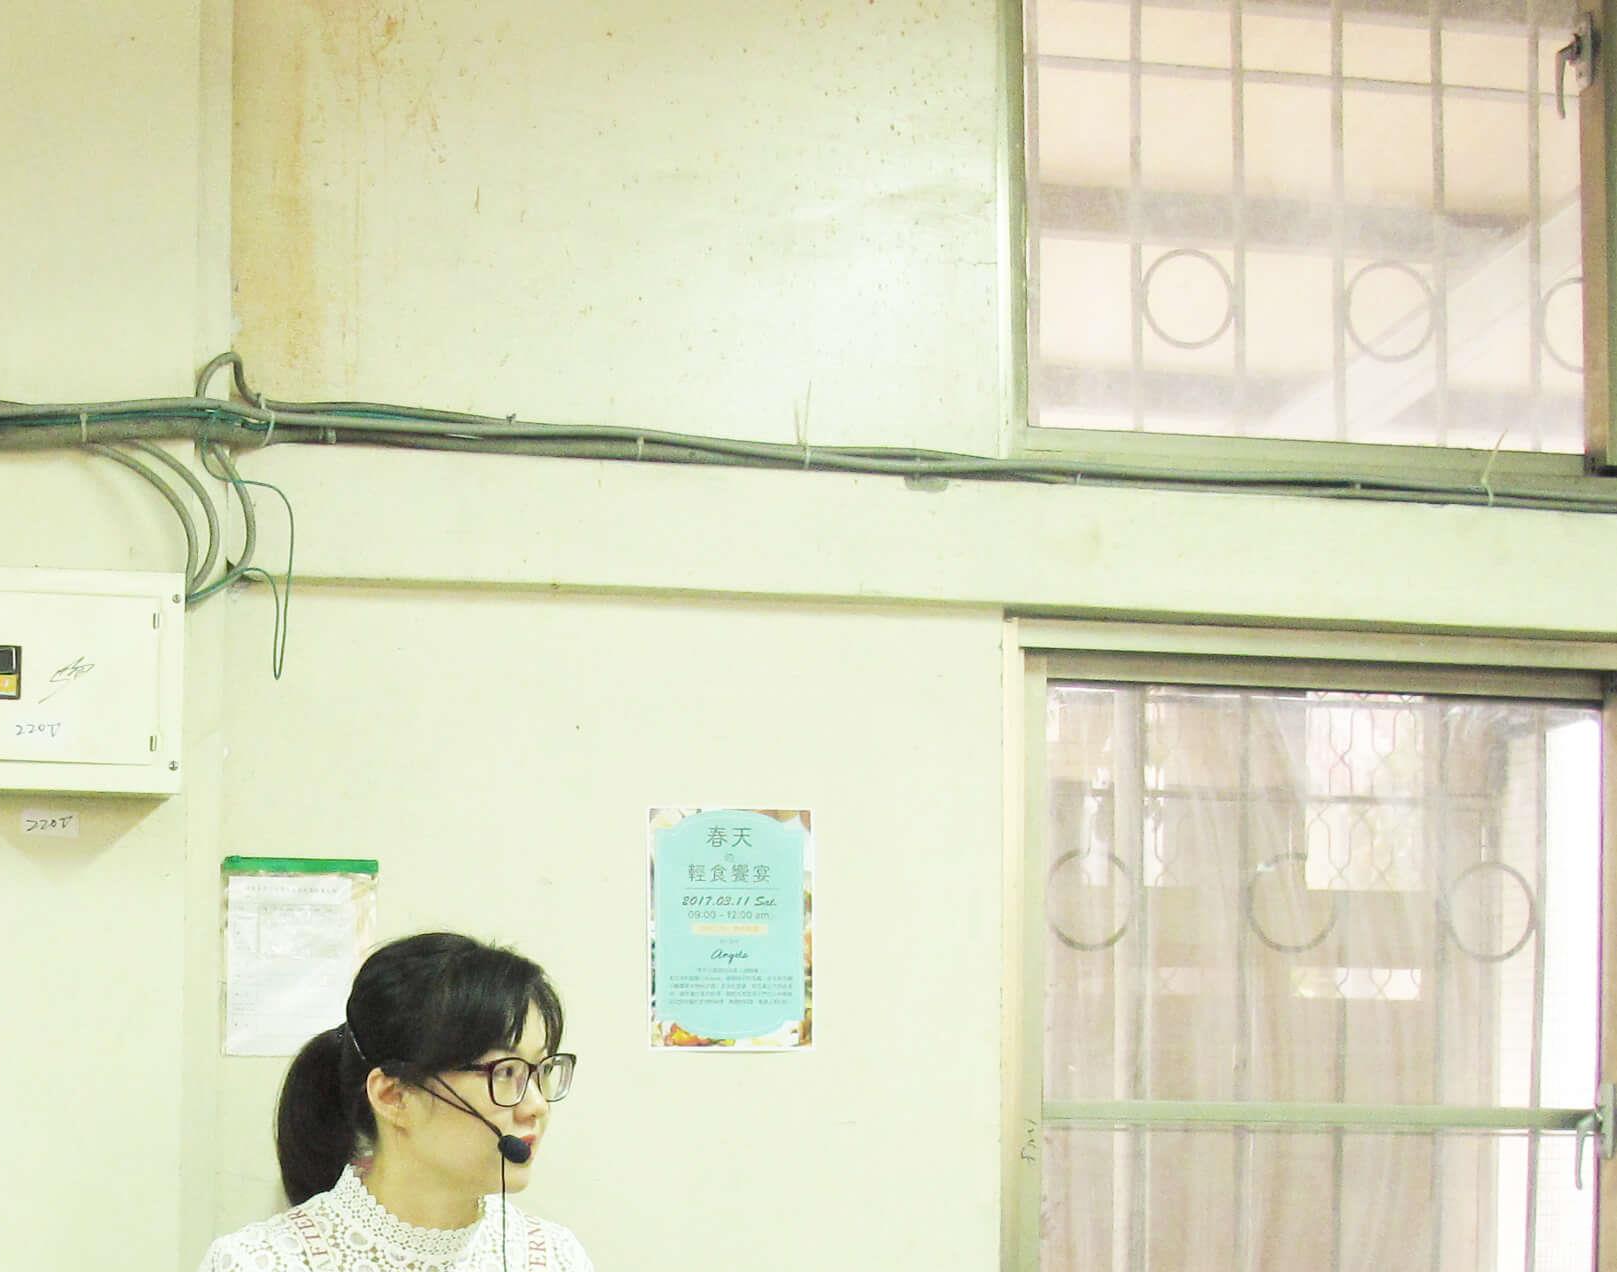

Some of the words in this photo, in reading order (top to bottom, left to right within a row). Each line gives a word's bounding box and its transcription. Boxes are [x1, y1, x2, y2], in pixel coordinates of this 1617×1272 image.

[706, 825, 753, 848] 春天
[687, 863, 771, 883] 輕食饗宴
